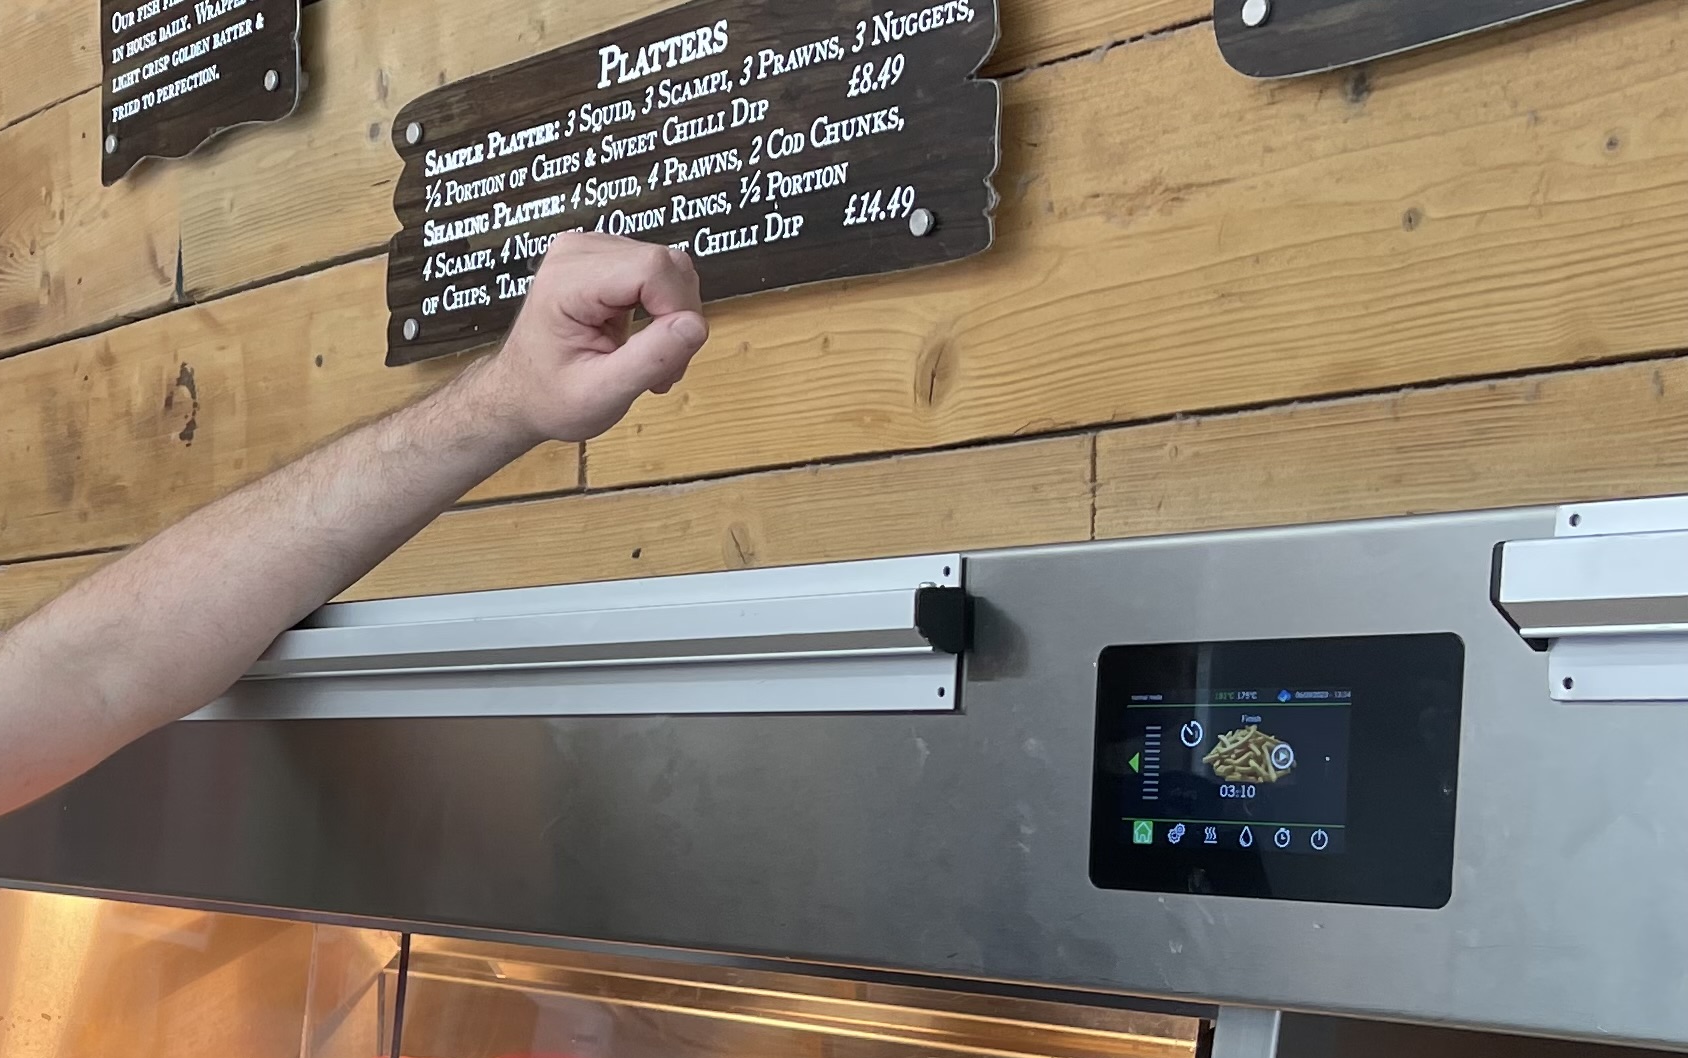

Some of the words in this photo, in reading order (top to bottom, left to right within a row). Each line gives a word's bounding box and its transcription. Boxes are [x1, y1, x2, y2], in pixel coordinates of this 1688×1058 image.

[112, 12, 135, 33] OUR
[137, 0, 160, 22] FISH
[112, 45, 124, 64] IN
[126, 31, 157, 57] HOUSE
[159, 15, 191, 42] DAILY.
[112, 68, 141, 93] LIGHT
[142, 55, 170, 80] CRISP
[172, 36, 210, 67] GOLDEN
[212, 19, 253, 50] BATTER
[255, 12, 265, 30] &
[597, 19, 729, 89] PLATTERS
[847, 53, 905, 98] £8.49
[112, 99, 141, 123] FRIED
[142, 92, 155, 110] TO
[157, 64, 220, 104] PERFECTION.
[424, 143, 484, 178] SAMPLE
[487, 120, 560, 160] PLATTER:
[564, 109, 576, 137] 3
[579, 99, 636, 134] SQUID,
[641, 86, 654, 115] 3
[658, 69, 733, 109] SCAMPI,
[740, 56, 753, 86] 3
[757, 36, 844, 80] PRAWNS,
[852, 20, 866, 53] 3
[871, 0, 975, 46] NUGGETS,
[423, 213, 489, 247] SHARING
[492, 193, 566, 230] PLATTER:
[570, 183, 582, 210] 4
[584, 175, 642, 207] SQUID,
[647, 162, 659, 191] 4
[662, 148, 743, 186] PRAWNS,
[749, 135, 762, 166] 2
[766, 127, 805, 159] COD
[810, 106, 905, 148] CHUNKS,
[444, 172, 505, 206] PORTION
[509, 166, 528, 189] OF
[531, 151, 580, 182] CHIPS
[585, 147, 597, 168] &
[600, 130, 658, 164] SWEET
[662, 110, 725, 146] CHILLI
[730, 97, 769, 128] DIP
[422, 256, 432, 282] 4
[435, 249, 496, 280] SCAMPI,
[500, 237, 511, 264] 4
[594, 214, 604, 233] 4
[609, 207, 666, 236] ONION
[670, 191, 732, 224] RINGS,
[765, 162, 849, 201] PORTION
[843, 185, 916, 226] £14.49
[694, 224, 759, 257] CHILLI
[764, 212, 804, 242] DIP
[422, 296, 439, 316] OF
[443, 285, 491, 311] CHIPS,
[496, 273, 535, 300] TART
[1219, 784, 1256, 798] 03:10
